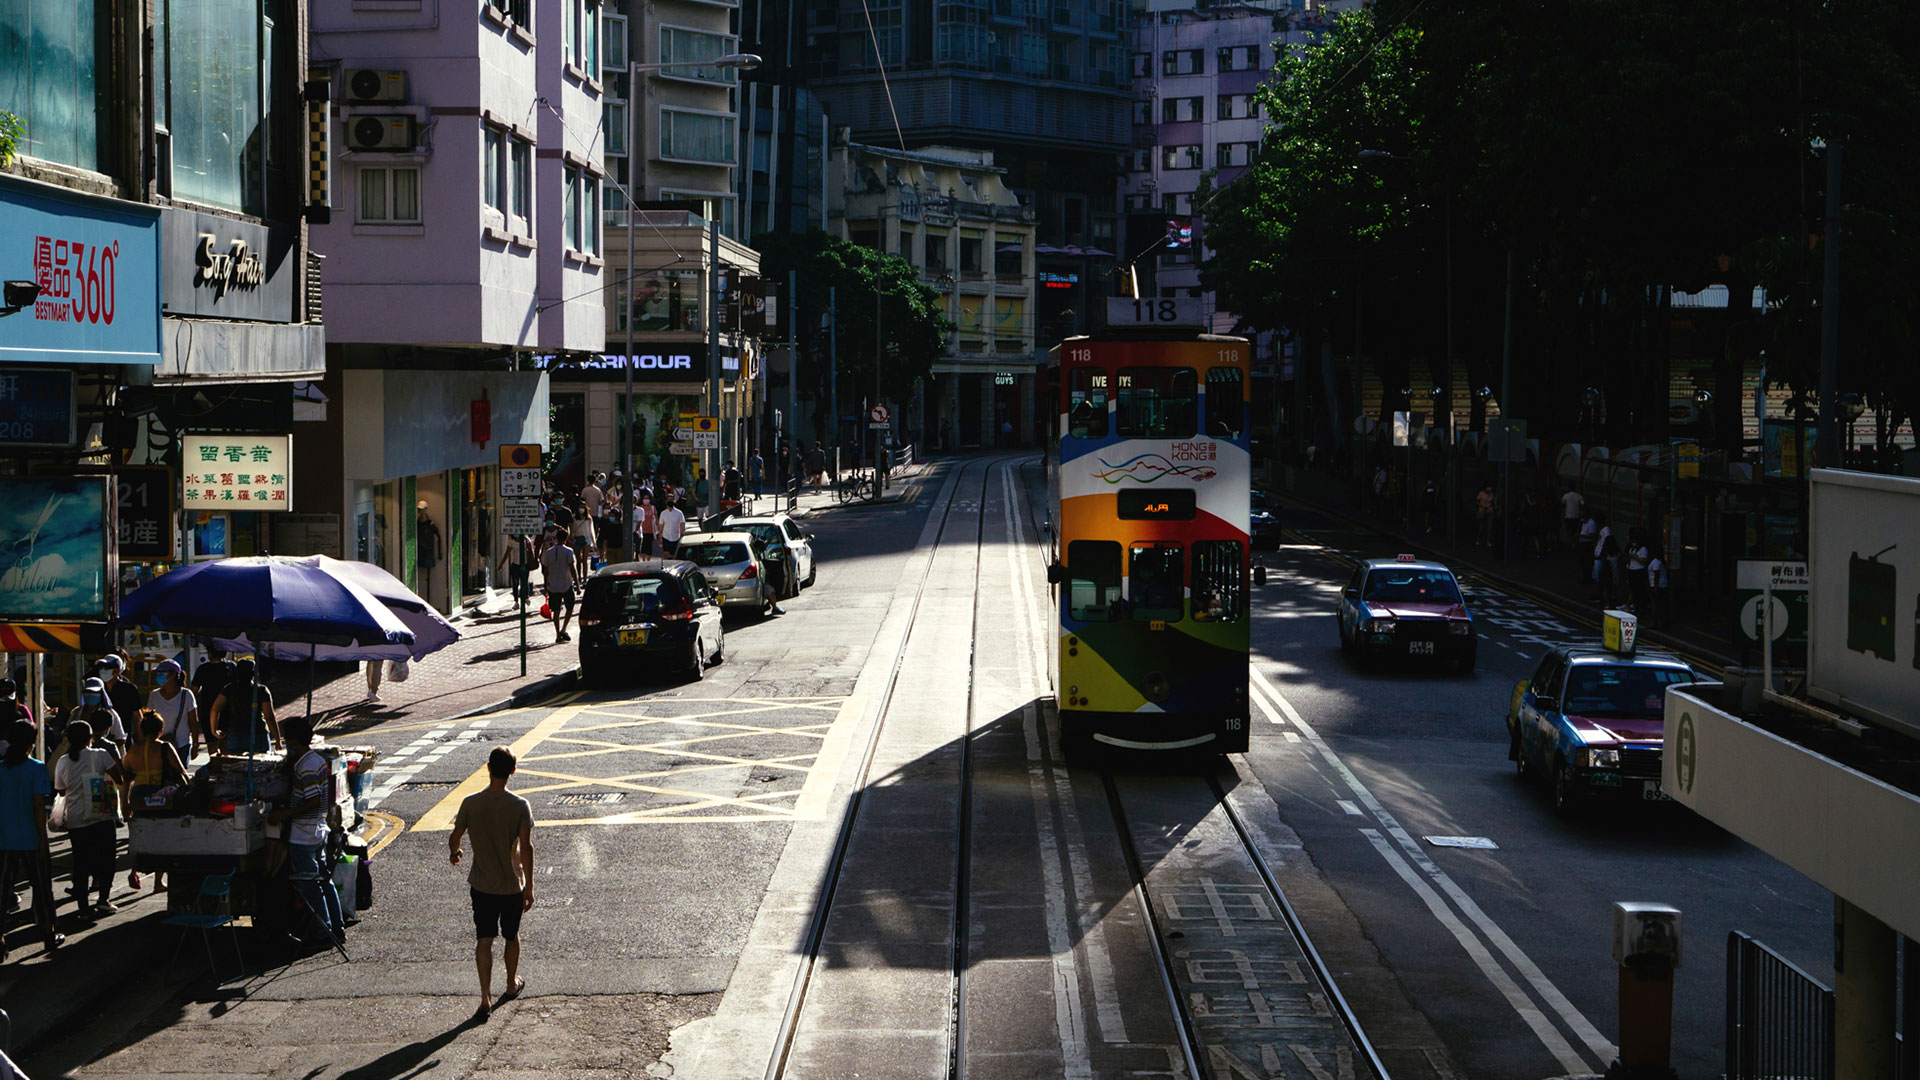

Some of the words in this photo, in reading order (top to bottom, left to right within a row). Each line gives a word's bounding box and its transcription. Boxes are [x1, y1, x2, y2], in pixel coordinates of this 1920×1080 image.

[34, 235, 71, 298] 優品
[231, 239, 264, 285] Hair
[35, 301, 71, 322] BESTMART
[1133, 300, 1177, 323] 118
[1070, 349, 1092, 362] 118
[1218, 349, 1239, 362] 118
[995, 376, 1014, 384] GUYS
[1171, 443, 1208, 451] HONG
[1171, 452, 1208, 461] KONG
[516, 471, 539, 480] 8-10
[118, 482, 148, 508] 21
[1772, 566, 1808, 577] 柯布連
[1624, 629, 1633, 643] 的士
[1224, 718, 1241, 731] 118
